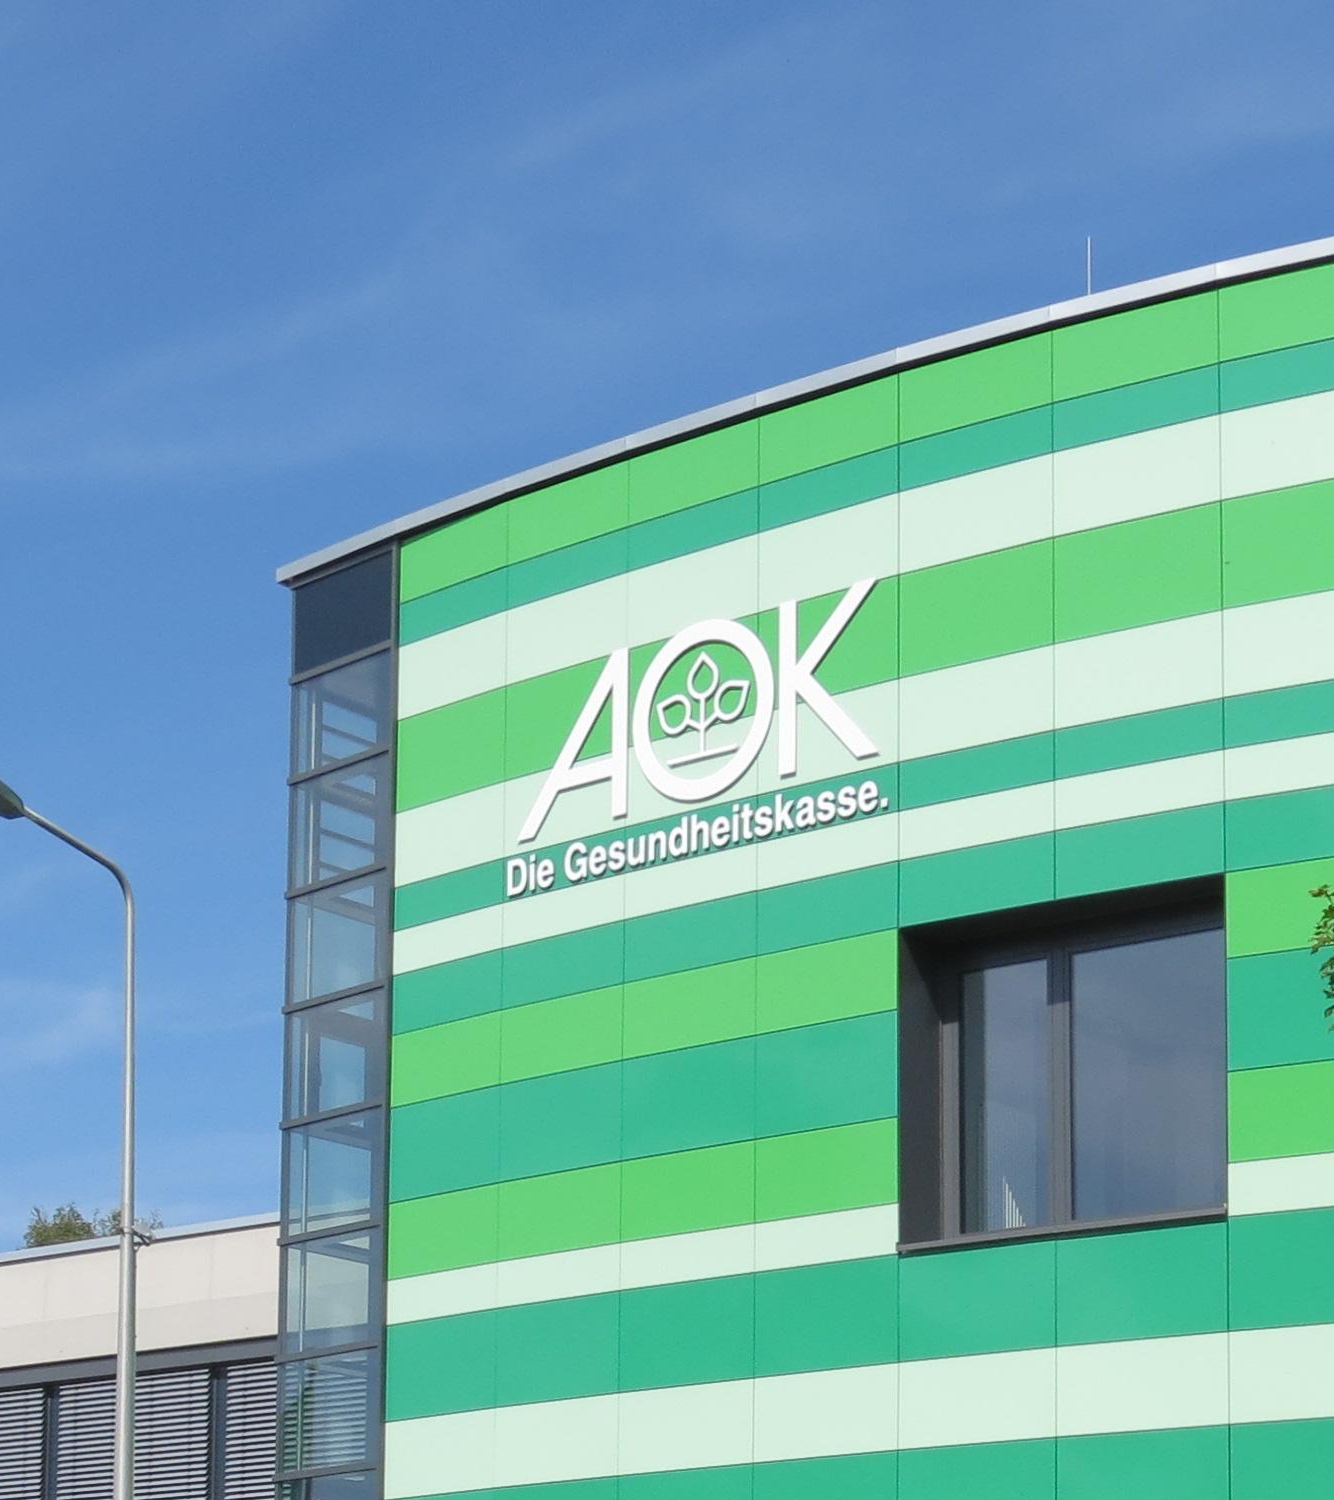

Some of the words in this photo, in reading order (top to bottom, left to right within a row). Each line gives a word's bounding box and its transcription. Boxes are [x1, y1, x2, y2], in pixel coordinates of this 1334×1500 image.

[517, 576, 880, 844] AOK
[505, 854, 555, 898] Die
[563, 779, 890, 884] Gesundheitskasse.
